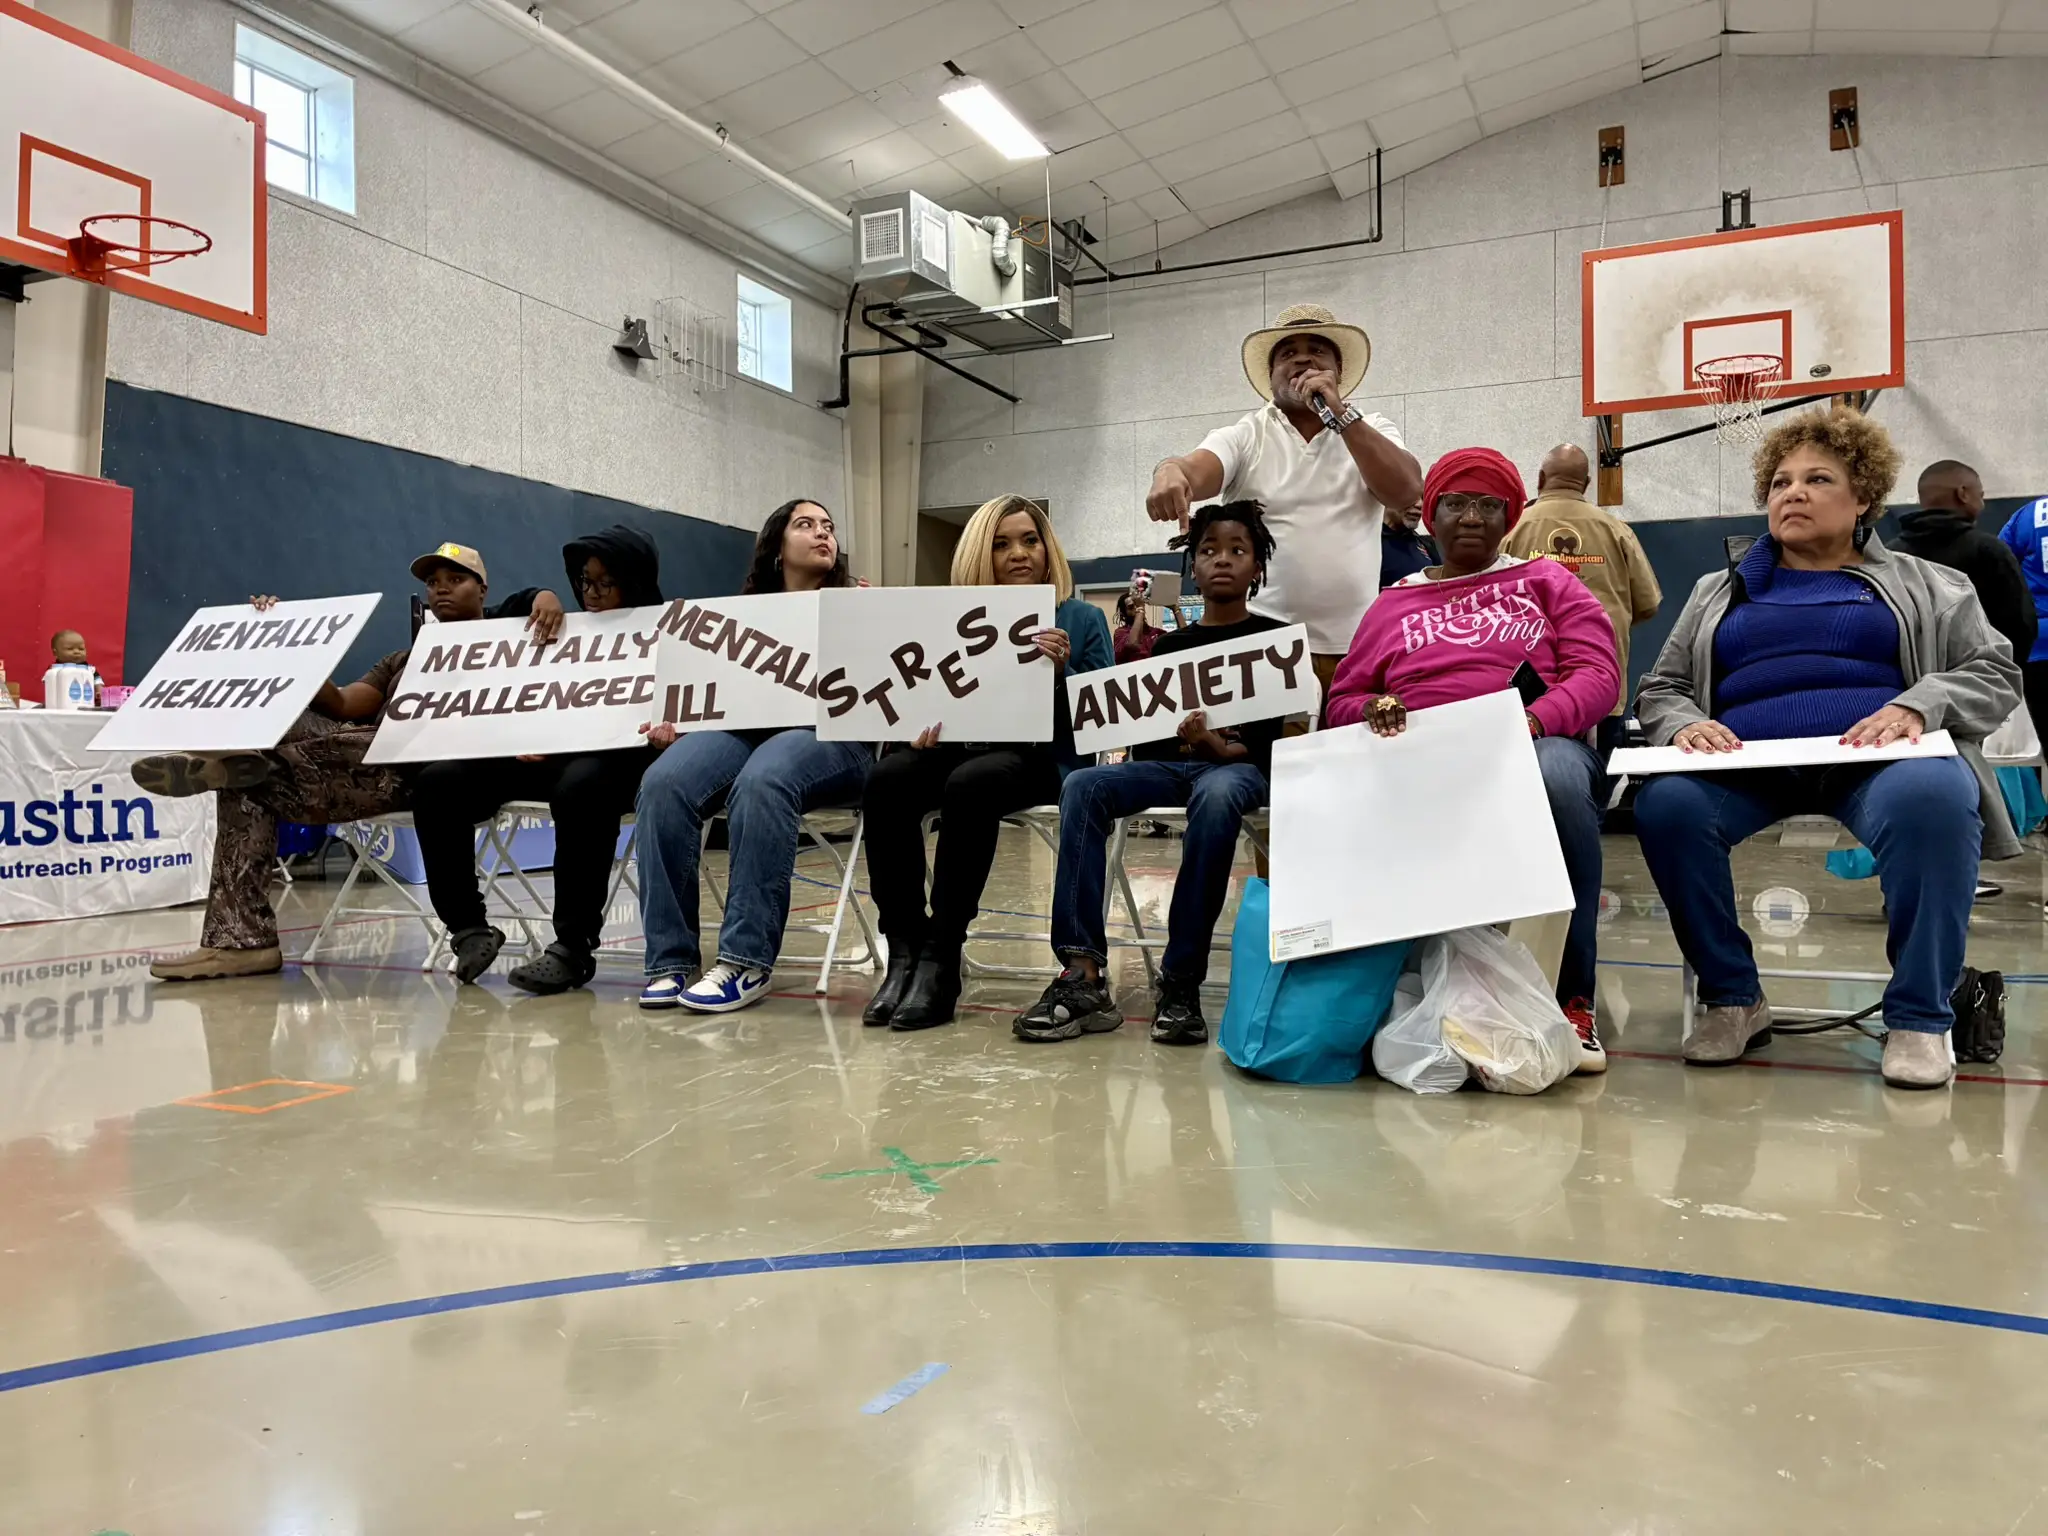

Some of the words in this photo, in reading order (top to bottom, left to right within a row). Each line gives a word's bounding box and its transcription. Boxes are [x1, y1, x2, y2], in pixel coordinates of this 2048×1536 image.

[175, 613, 354, 653] MENTALLY
[420, 629, 660, 674] MENTALLY
[657, 598, 817, 699] MENTAL
[818, 605, 1045, 726] STRESS
[1073, 638, 1304, 731] ANXIETY
[138, 676, 295, 710] HEALTHY
[386, 674, 656, 721] CHALLENGED
[663, 681, 726, 724] ILL
[101, 852, 193, 874] Program
